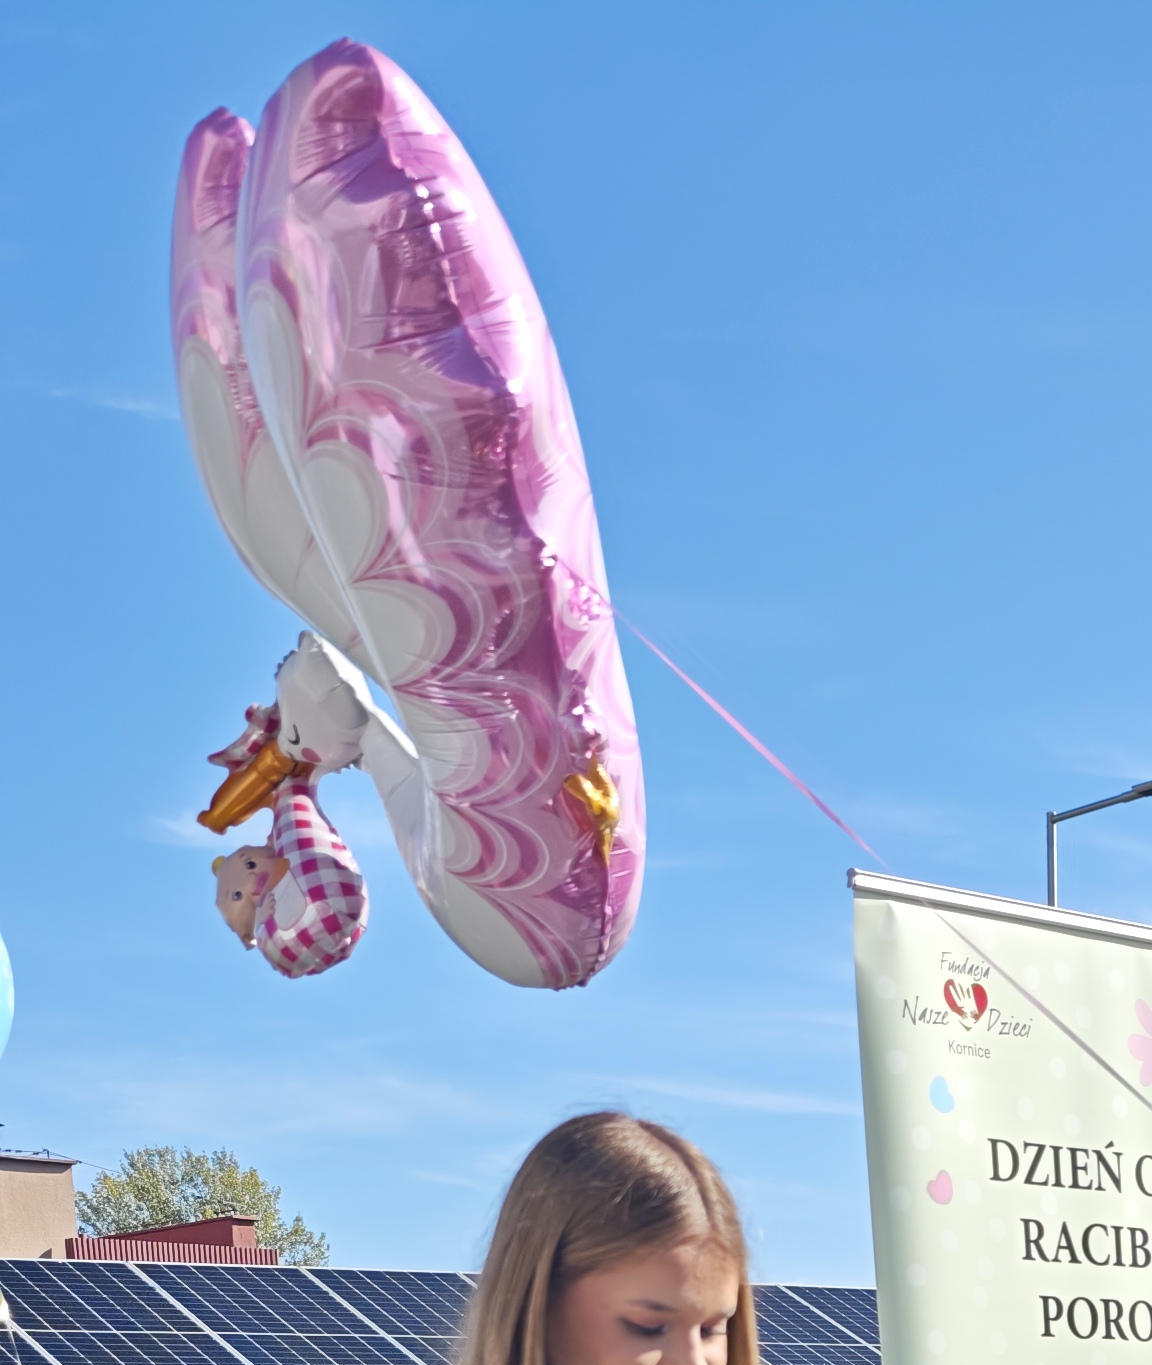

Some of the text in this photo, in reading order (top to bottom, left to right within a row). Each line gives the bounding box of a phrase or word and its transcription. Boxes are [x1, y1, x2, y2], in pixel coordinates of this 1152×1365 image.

[939, 951, 992, 982] Fundacja
[901, 995, 1034, 1039] Nasze Dzieci
[947, 1039, 992, 1060] Kornice
[986, 1135, 1124, 1195] DZIEŃ
